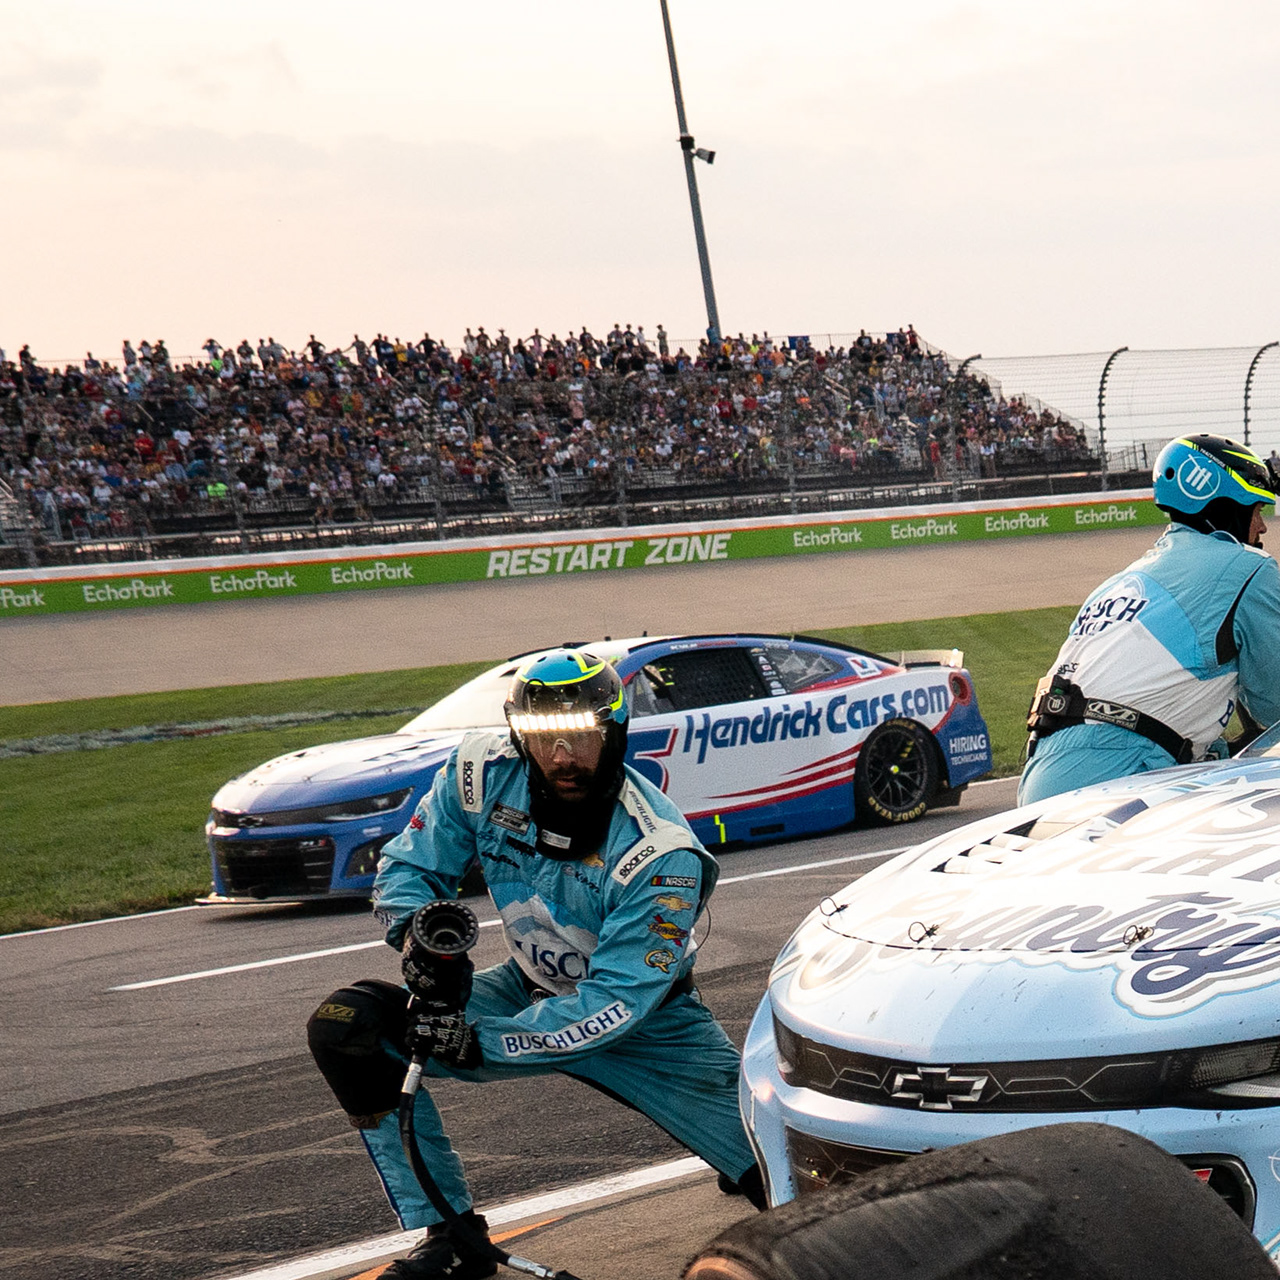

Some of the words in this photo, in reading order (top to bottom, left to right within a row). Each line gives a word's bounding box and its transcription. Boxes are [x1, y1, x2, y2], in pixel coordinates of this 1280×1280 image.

[985, 512, 1049, 532] EchoPark
[1075, 505, 1137, 525] EchoPark
[793, 527, 862, 547] EchoPark
[891, 518, 958, 540] EchoPark
[487, 541, 634, 578] RESTART
[644, 533, 732, 565] ZONE
[210, 570, 298, 593] EchoPark
[331, 561, 414, 584] EchoPark
[83, 579, 174, 604] EchoPark
[949, 734, 987, 754] HIRING
[950, 751, 988, 766] TECHNICIANS
[664, 875, 697, 888] NASCAR
